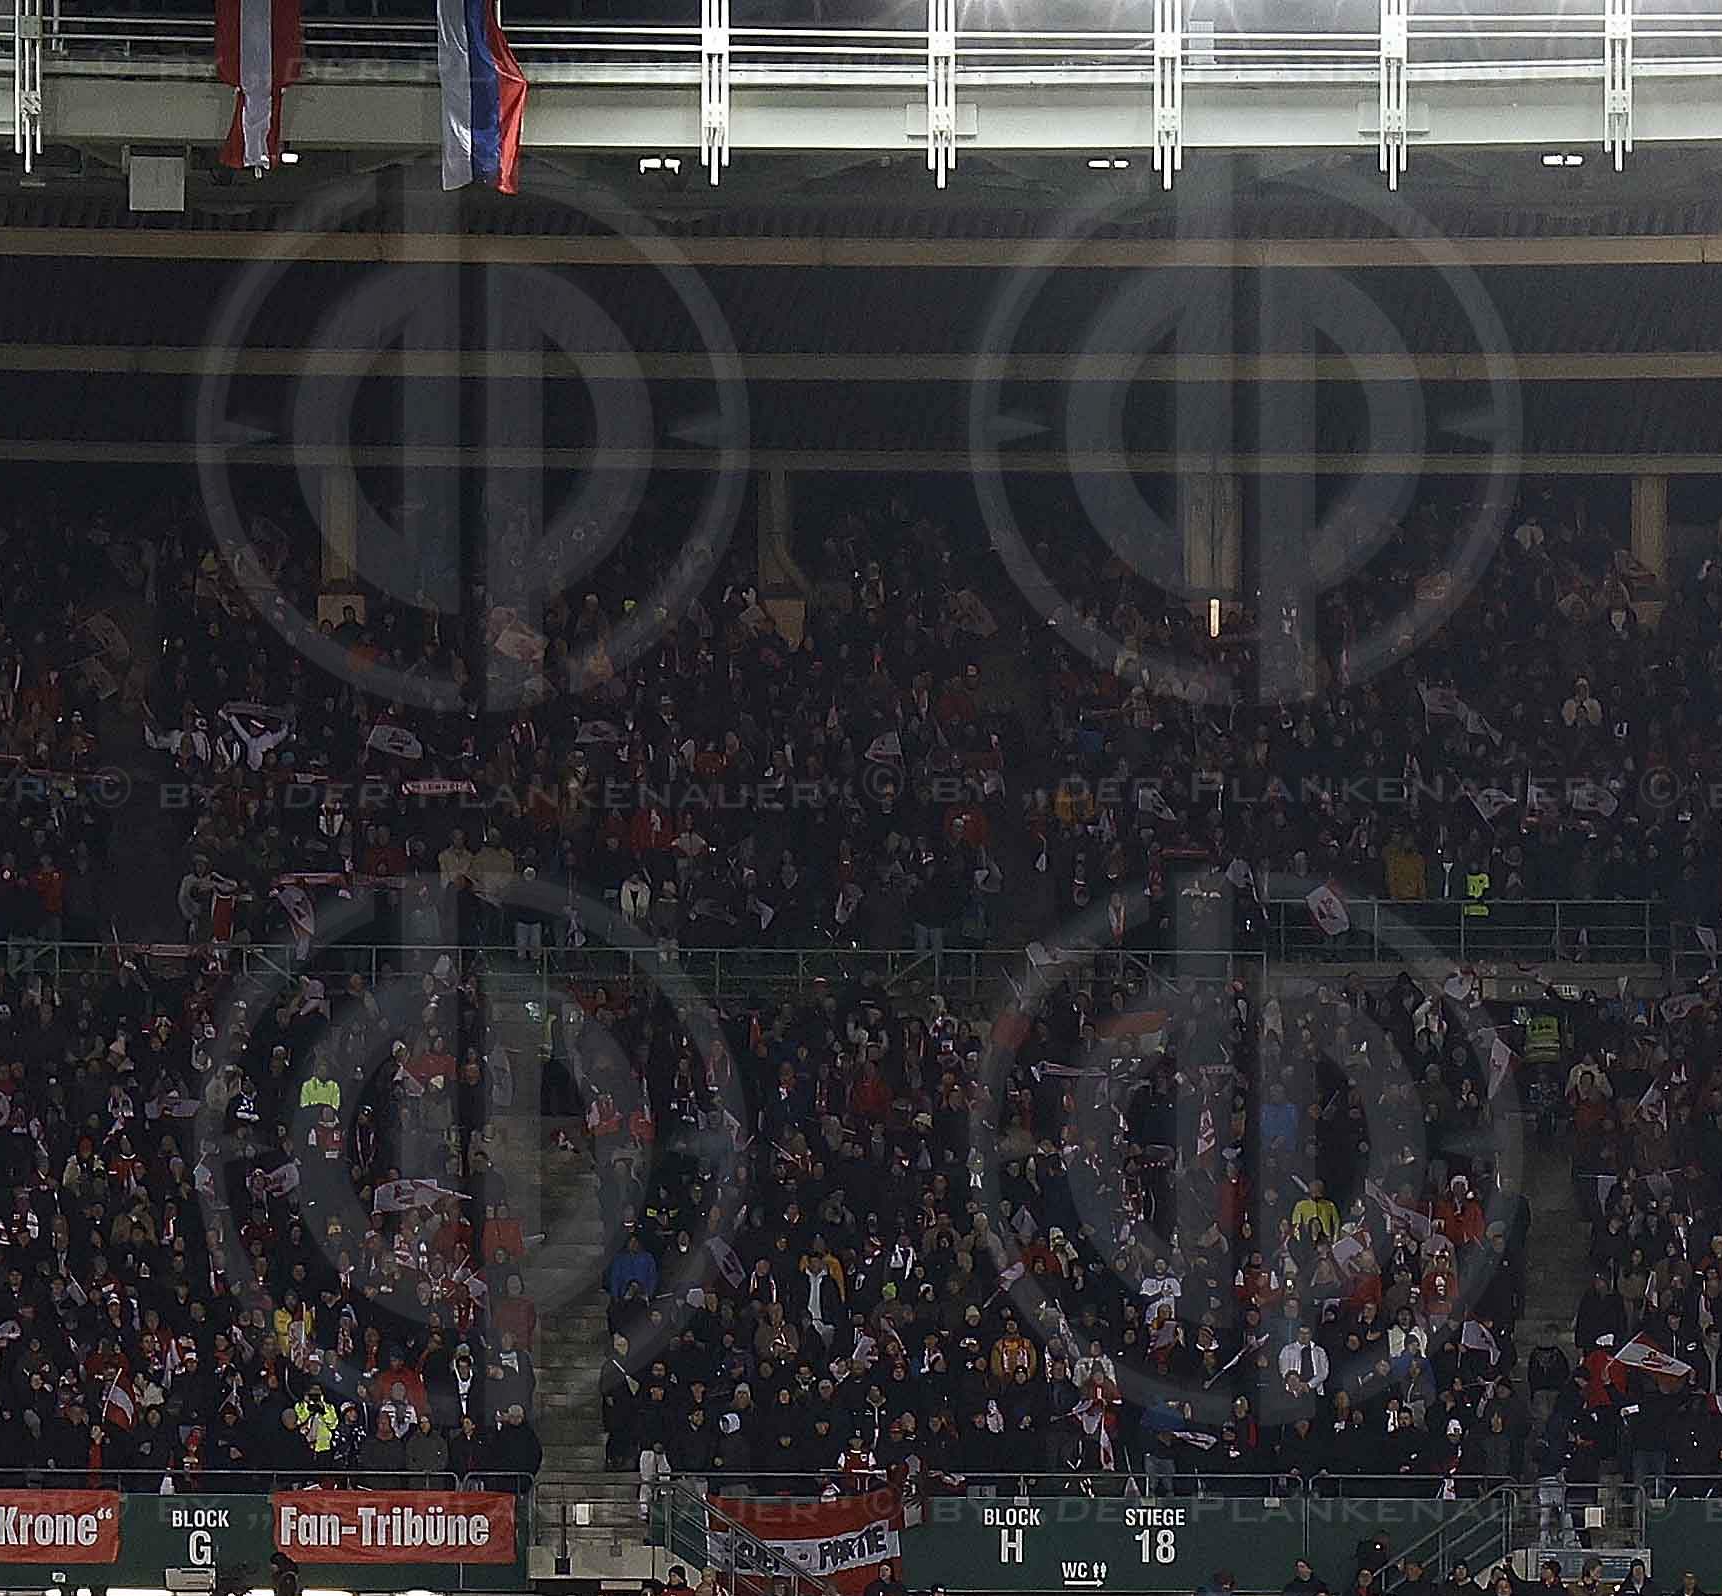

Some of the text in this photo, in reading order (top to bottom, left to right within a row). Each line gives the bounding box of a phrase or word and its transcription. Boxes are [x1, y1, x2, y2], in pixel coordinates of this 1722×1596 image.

[171, 1509, 229, 1528] BLOCK
[279, 1506, 490, 1547] Fan-Tribüne
[984, 1508, 1040, 1526] BLOCK
[1124, 1508, 1185, 1526] STIEGE
[188, 1530, 213, 1565] G
[1000, 1529, 1023, 1562] H
[1135, 1529, 1176, 1563] 18
[1062, 1562, 1090, 1578] WC
